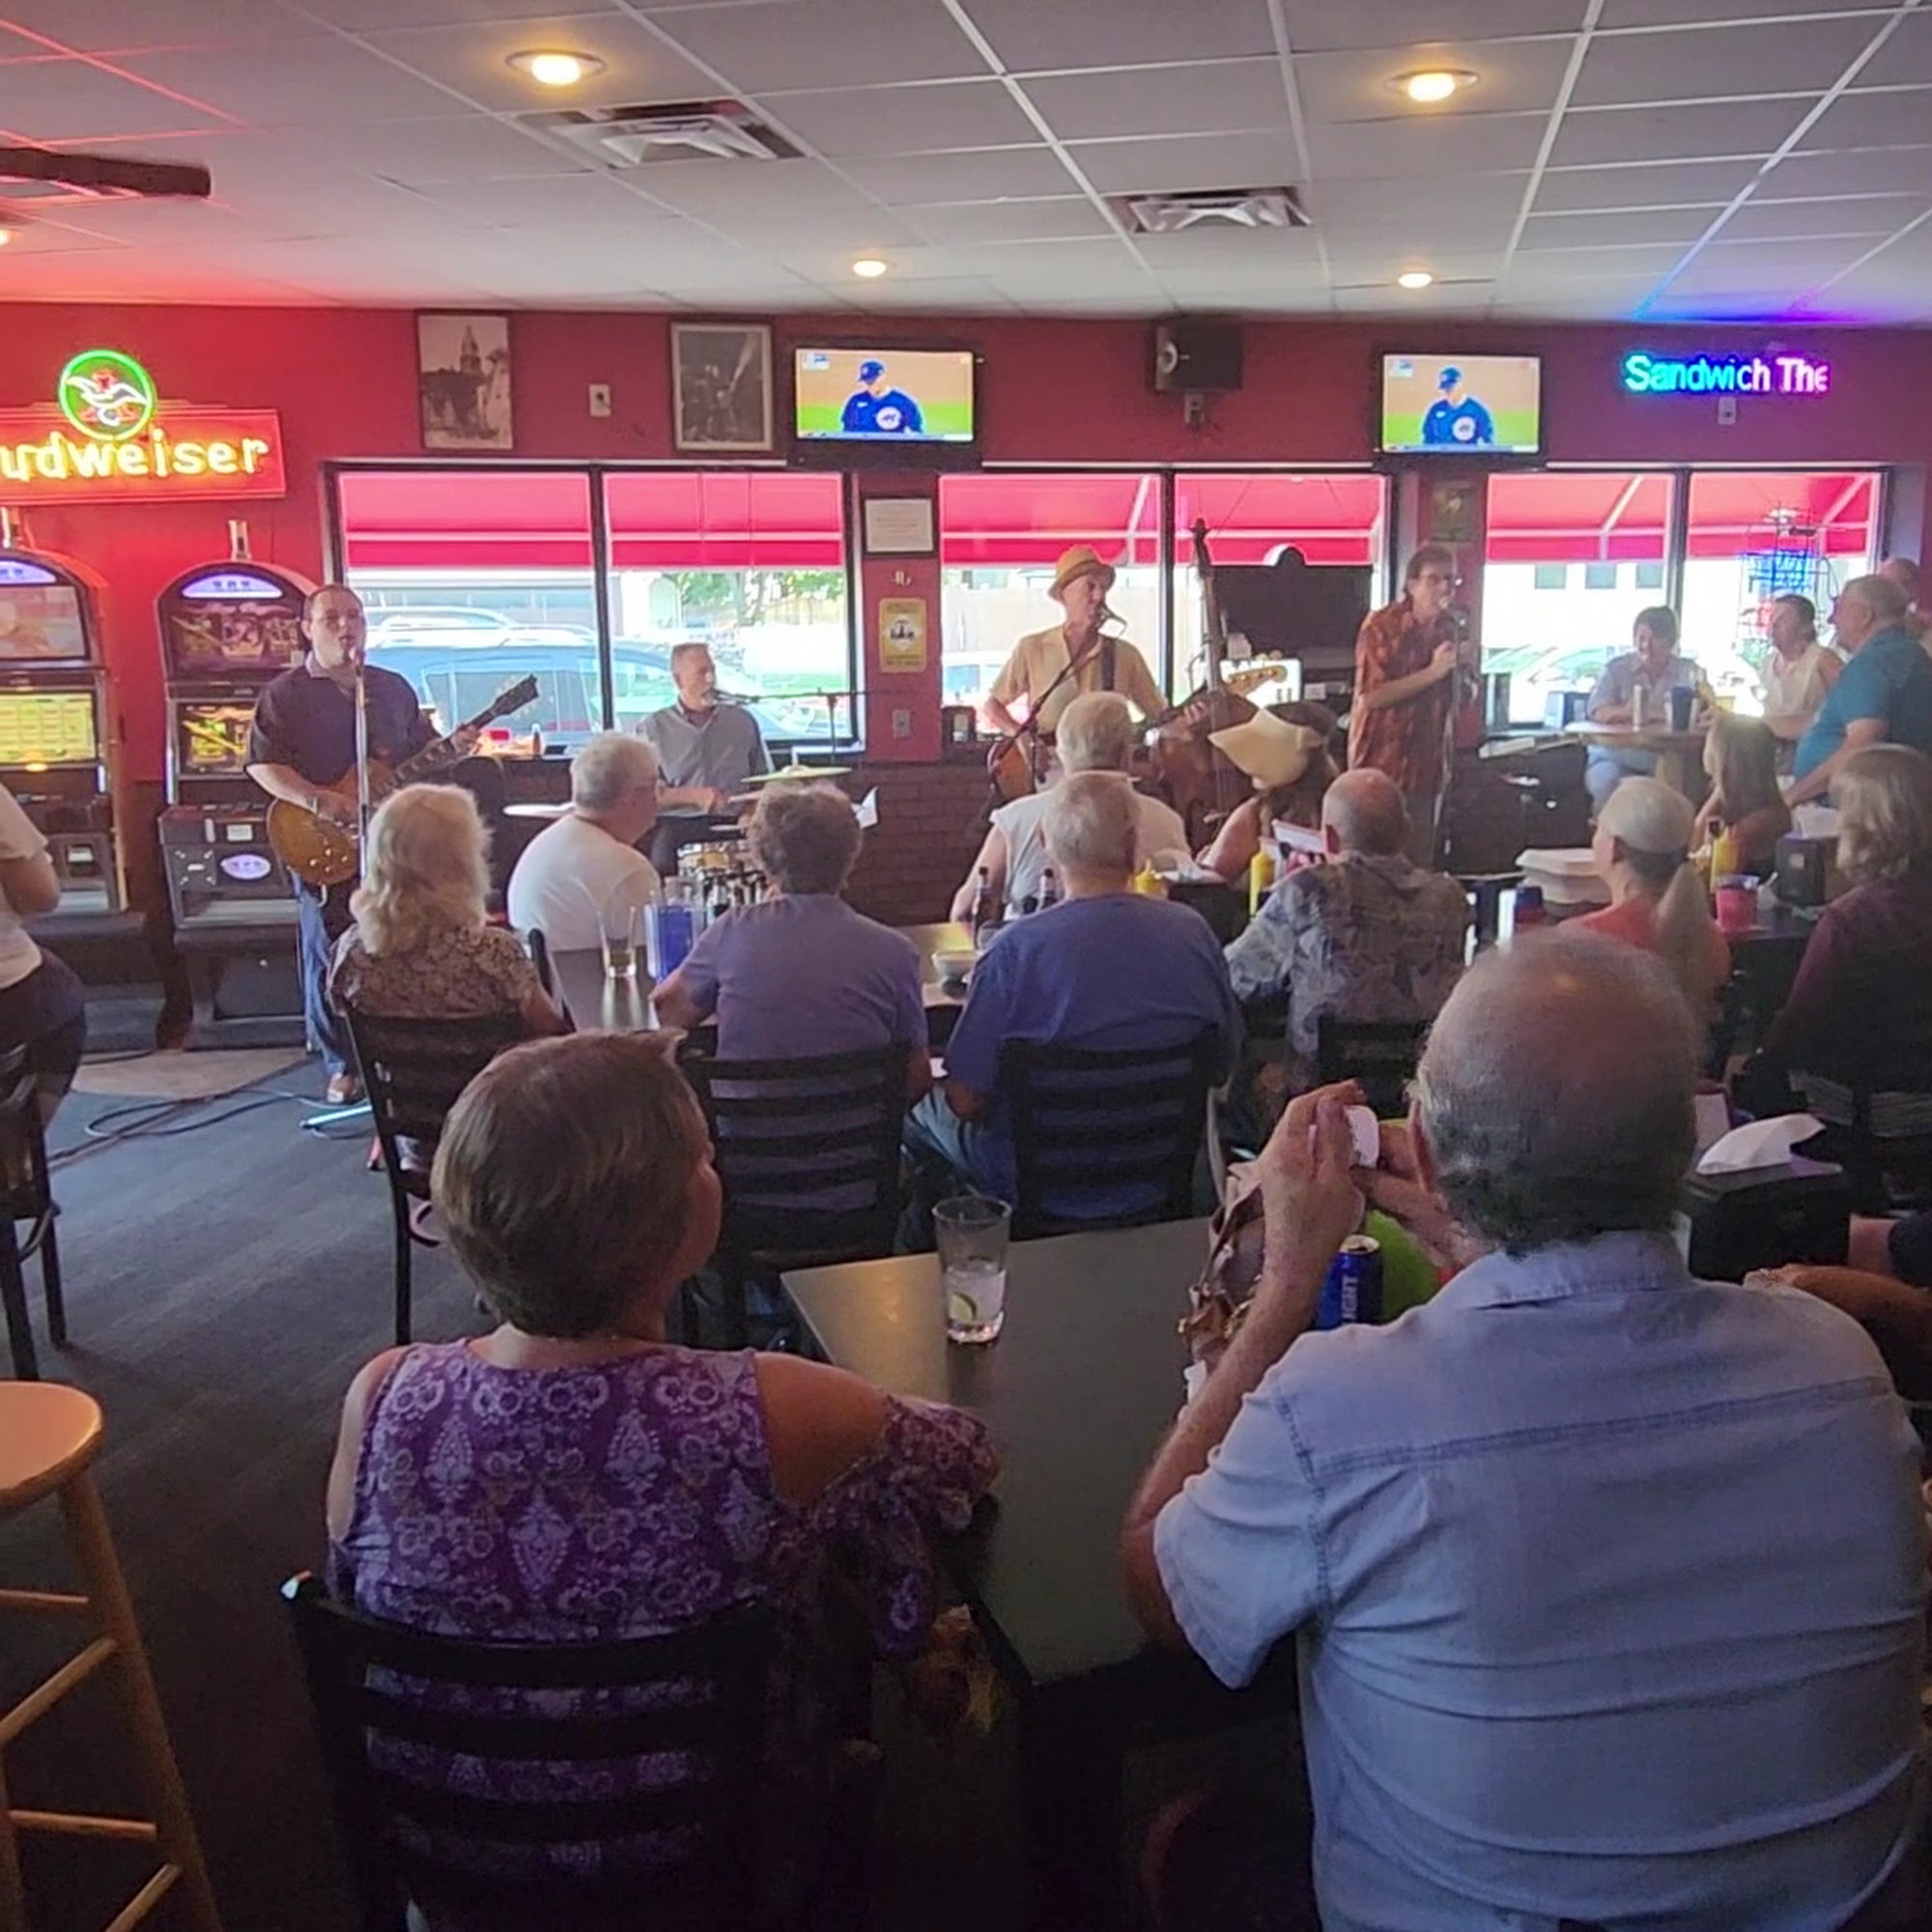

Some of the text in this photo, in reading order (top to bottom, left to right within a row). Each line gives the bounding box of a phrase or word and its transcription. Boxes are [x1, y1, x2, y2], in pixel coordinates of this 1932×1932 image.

[1625, 355, 1772, 391] Sandwich
[0, 428, 270, 482] udweiser
[1341, 1274, 1359, 1322] IGHT
